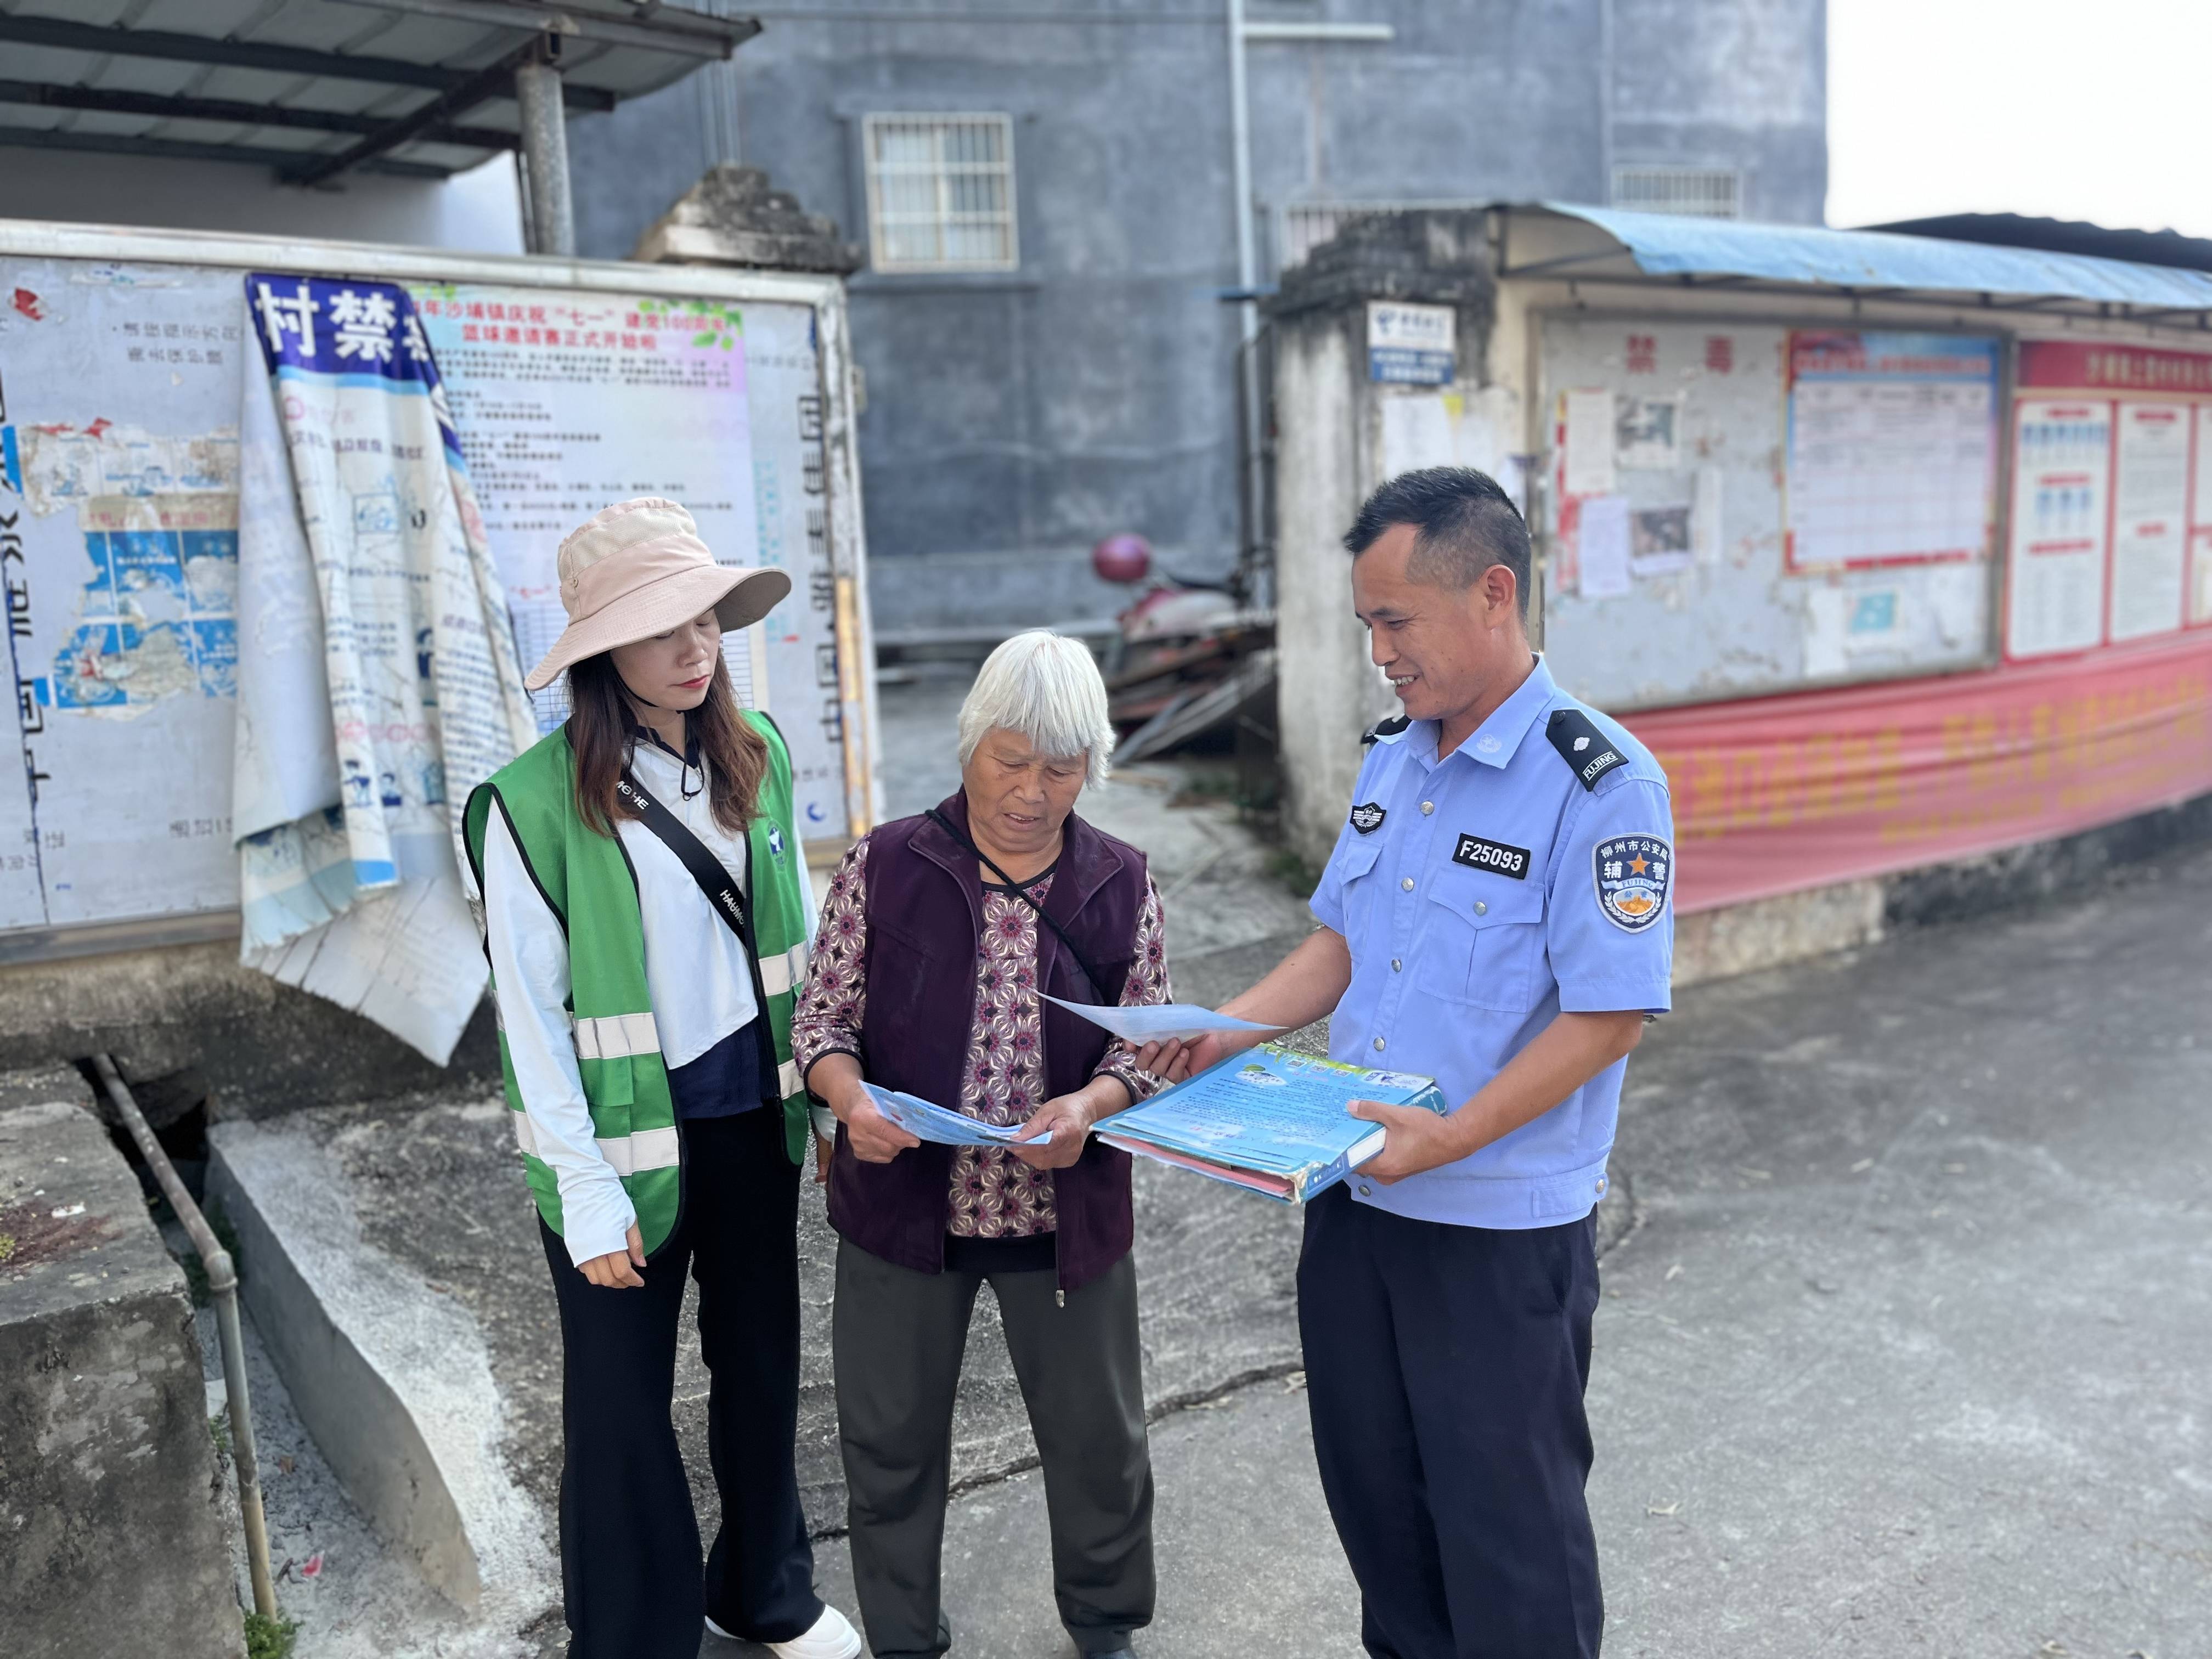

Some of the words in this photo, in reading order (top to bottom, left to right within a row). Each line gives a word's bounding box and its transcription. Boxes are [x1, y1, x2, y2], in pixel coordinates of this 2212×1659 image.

[1584, 753, 1617, 779] FUJING
[1459, 840, 1523, 871] F25093
[1600, 840, 1669, 861] 柳州市公安局
[1622, 879, 1653, 888] FUJING
